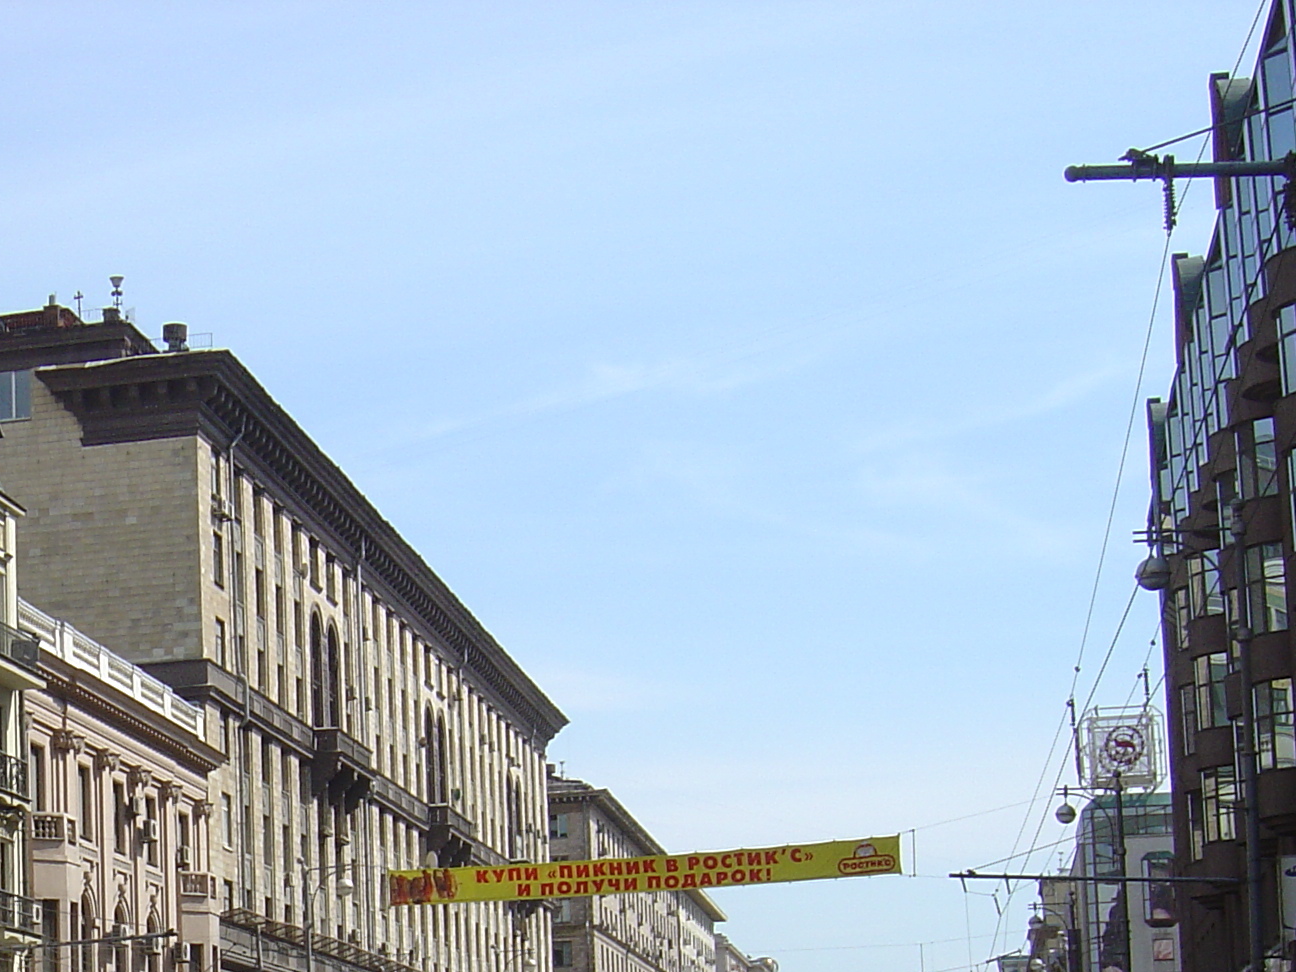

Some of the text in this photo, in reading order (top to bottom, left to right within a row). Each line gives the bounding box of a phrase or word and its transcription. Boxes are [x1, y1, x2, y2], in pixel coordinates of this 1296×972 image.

[476, 867, 538, 884] КУПИ
[548, 859, 657, 879] «ПИКНИК
[666, 858, 679, 872] В
[517, 868, 772, 897] И ПОЛУЧИ ПОДАРОК!
